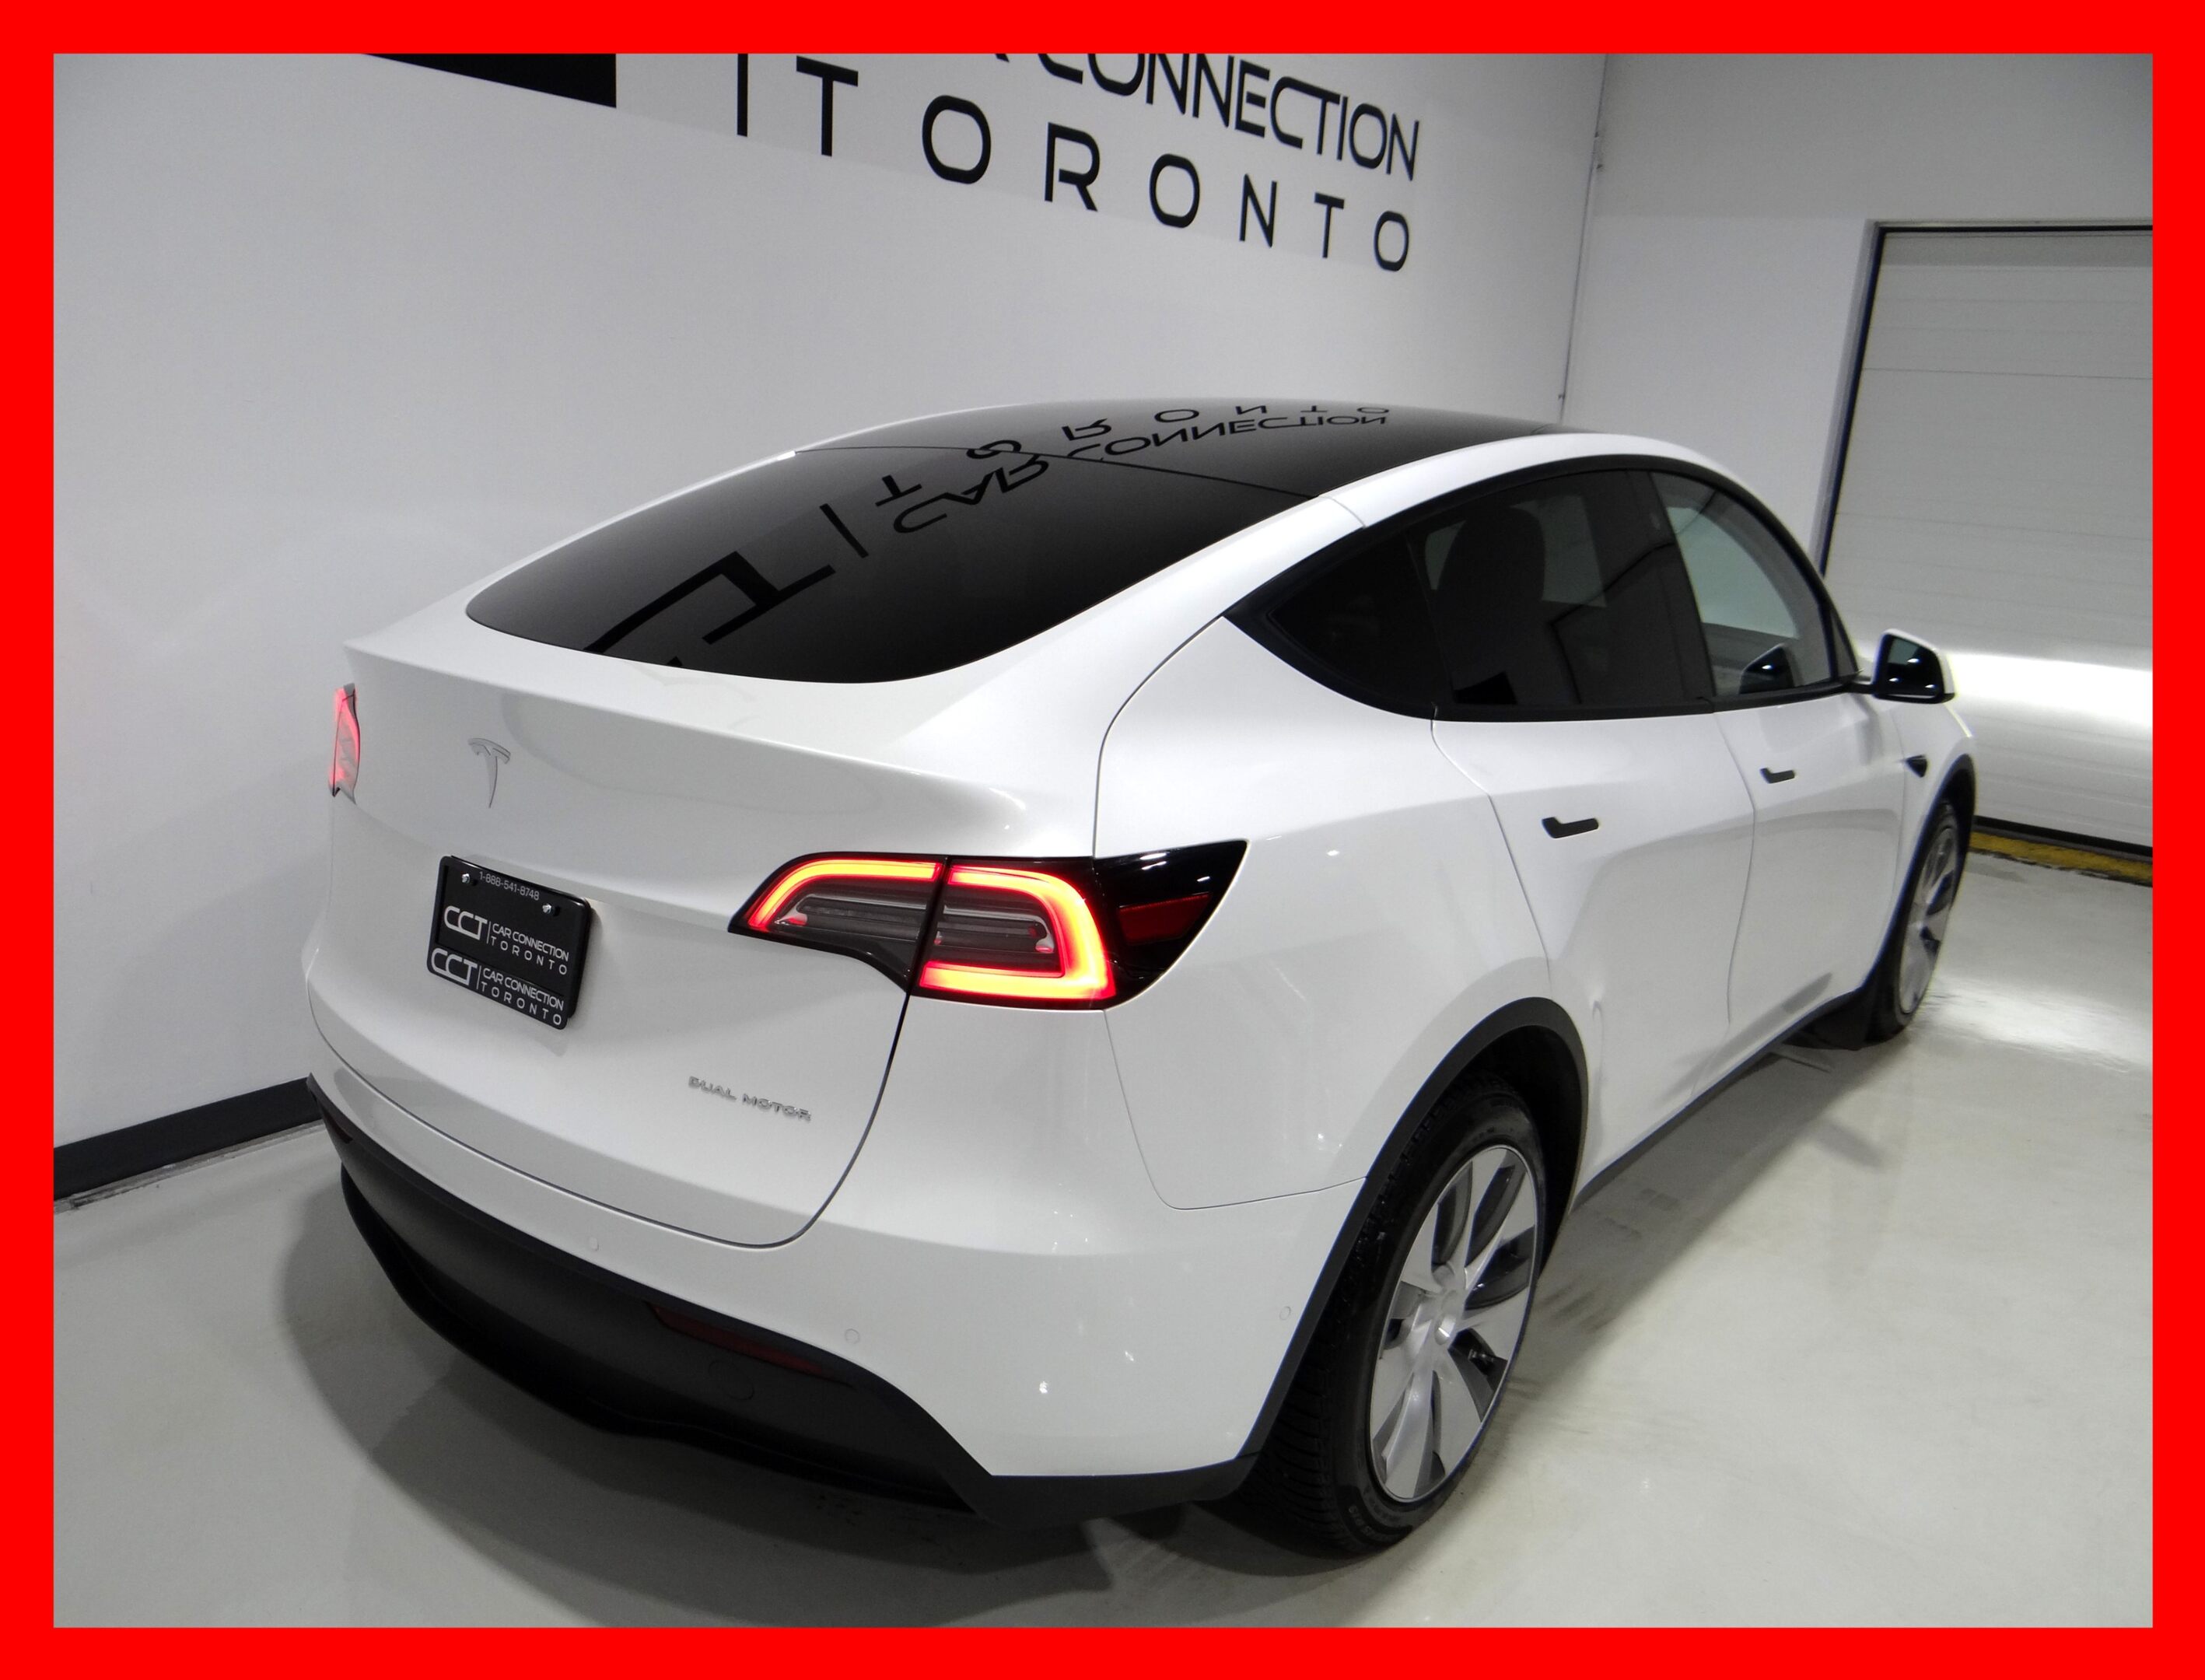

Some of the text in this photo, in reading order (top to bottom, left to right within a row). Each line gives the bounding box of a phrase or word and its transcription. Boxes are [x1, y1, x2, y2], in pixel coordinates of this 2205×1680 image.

[796, 57, 1409, 271] TORONTO
[479, 871, 540, 901] 1-888-541-8748
[444, 905, 488, 940] CCT
[492, 923, 569, 961] CAR CONNECTION
[431, 947, 478, 986] CCT
[490, 936, 567, 975] TORONTO
[481, 982, 562, 1025] TORONTO
[483, 968, 564, 1011] CAR CONNECTION
[688, 1076, 811, 1122] DUAL MOTOR
